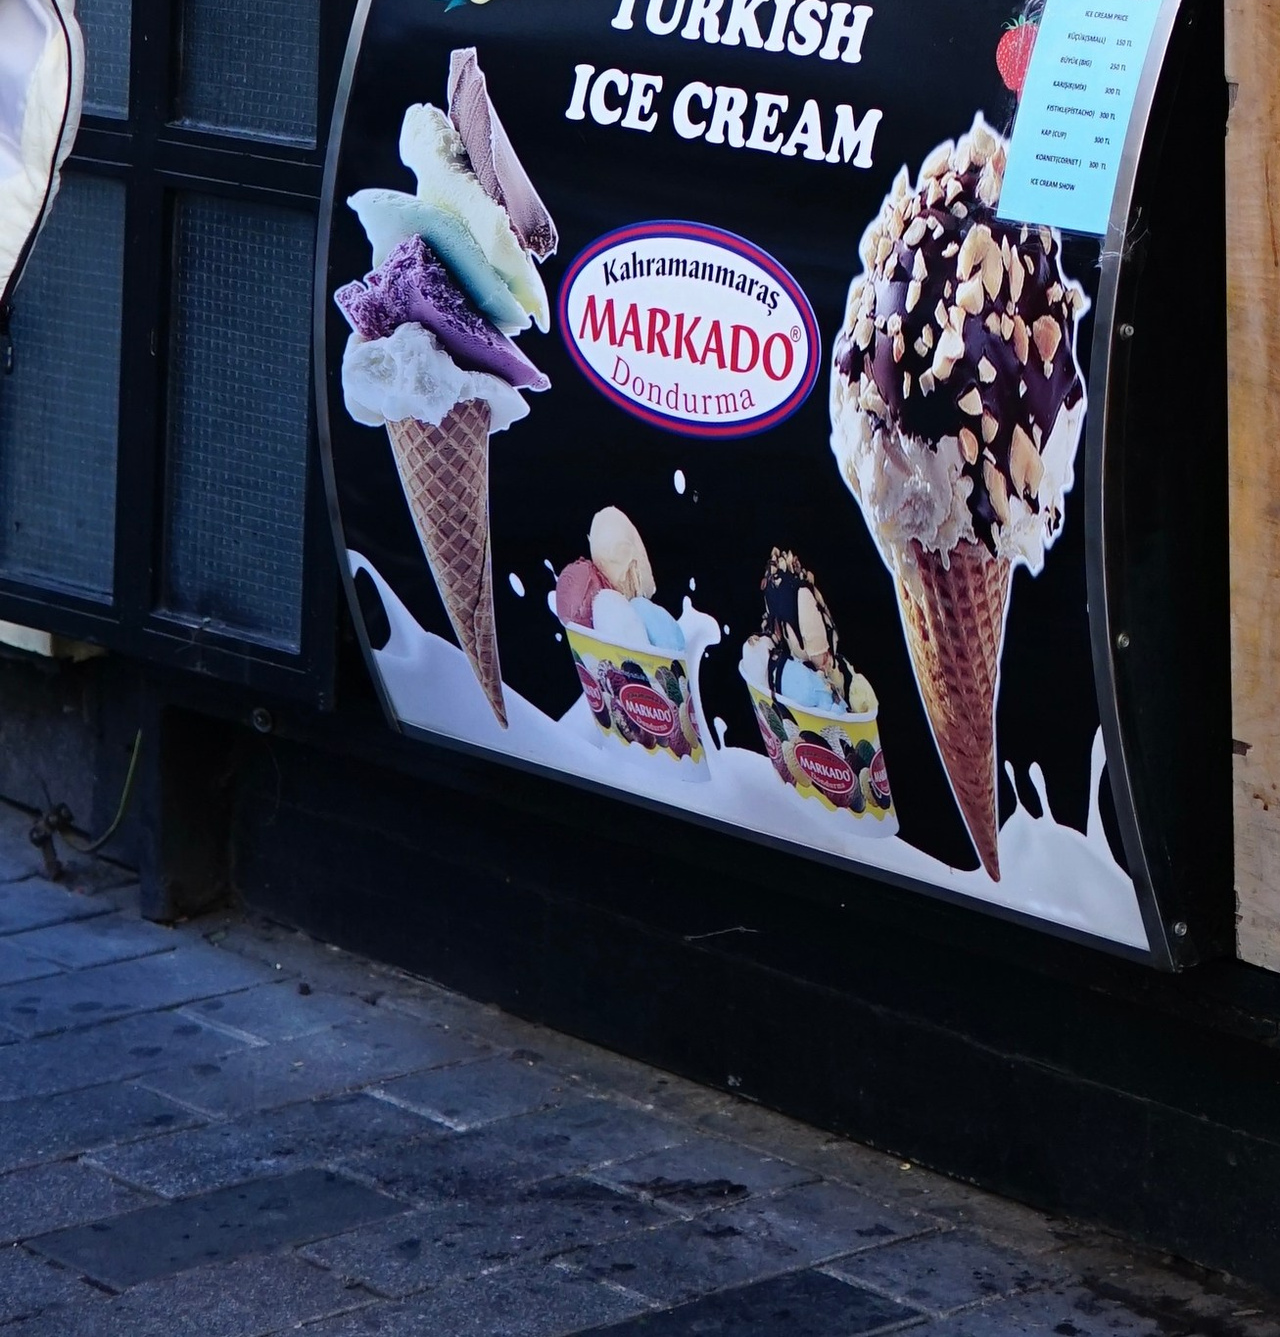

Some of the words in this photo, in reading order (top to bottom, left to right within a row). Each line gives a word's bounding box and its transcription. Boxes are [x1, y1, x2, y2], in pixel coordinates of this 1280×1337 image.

[1094, 11, 1114, 20] CREAM
[565, 63, 663, 132] ICE
[672, 80, 883, 170] CREAM
[1041, 129, 1052, 137] KAP
[1052, 130, 1067, 140] (CUP)
[1030, 178, 1039, 186] ICE
[1039, 179, 1058, 189] CREAM
[1058, 182, 1076, 192] SHOW
[602, 251, 781, 317] Kahramanmaraş
[578, 294, 794, 382] MARKADO
[610, 355, 756, 416] Dondurma
[625, 699, 672, 723] MARKADO
[799, 756, 851, 782] MARKADO
